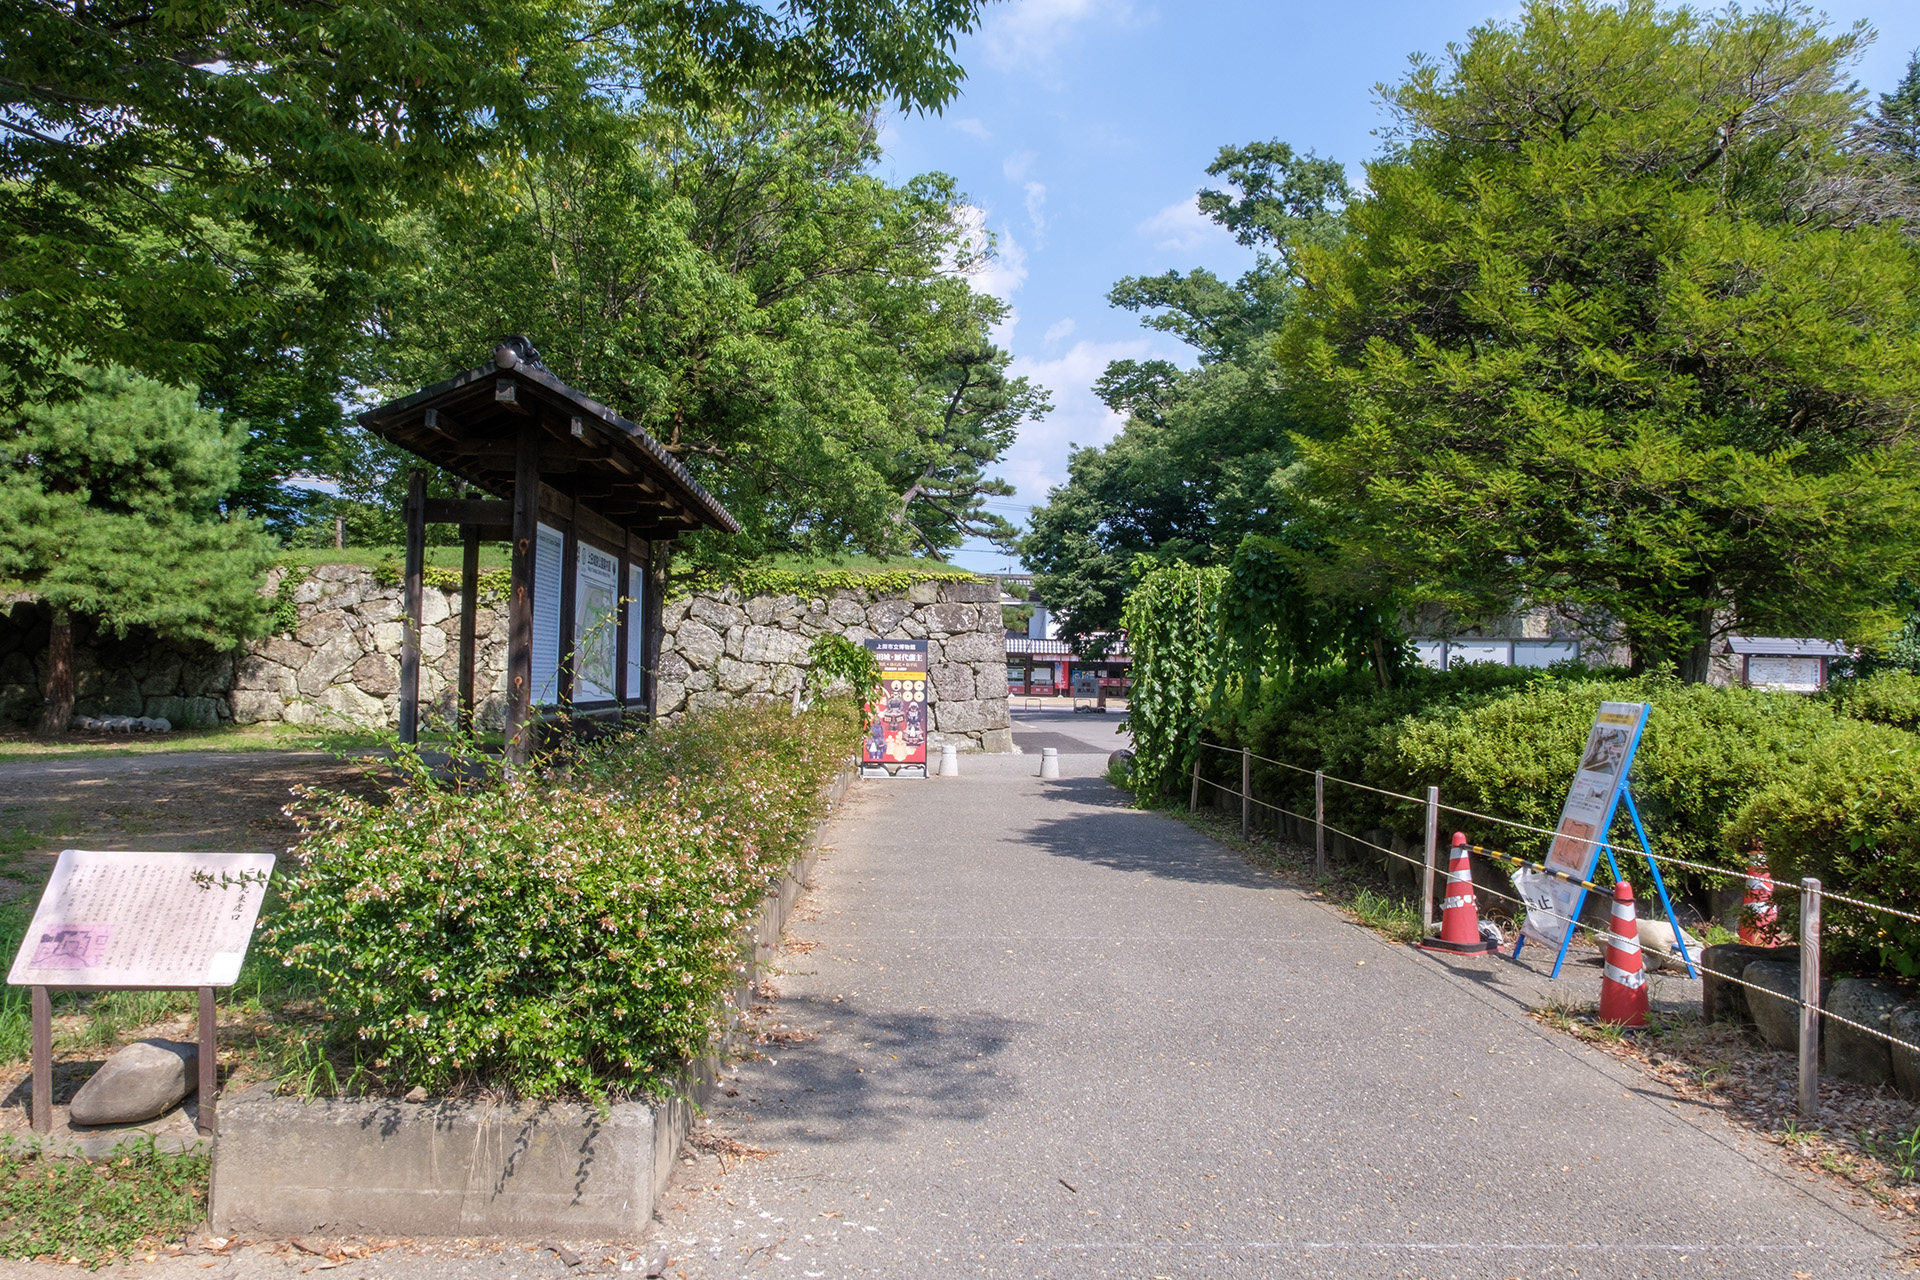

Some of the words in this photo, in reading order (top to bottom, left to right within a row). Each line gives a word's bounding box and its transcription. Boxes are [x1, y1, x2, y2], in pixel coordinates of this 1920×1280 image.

[231, 867, 255, 921] 二丸東虎口
